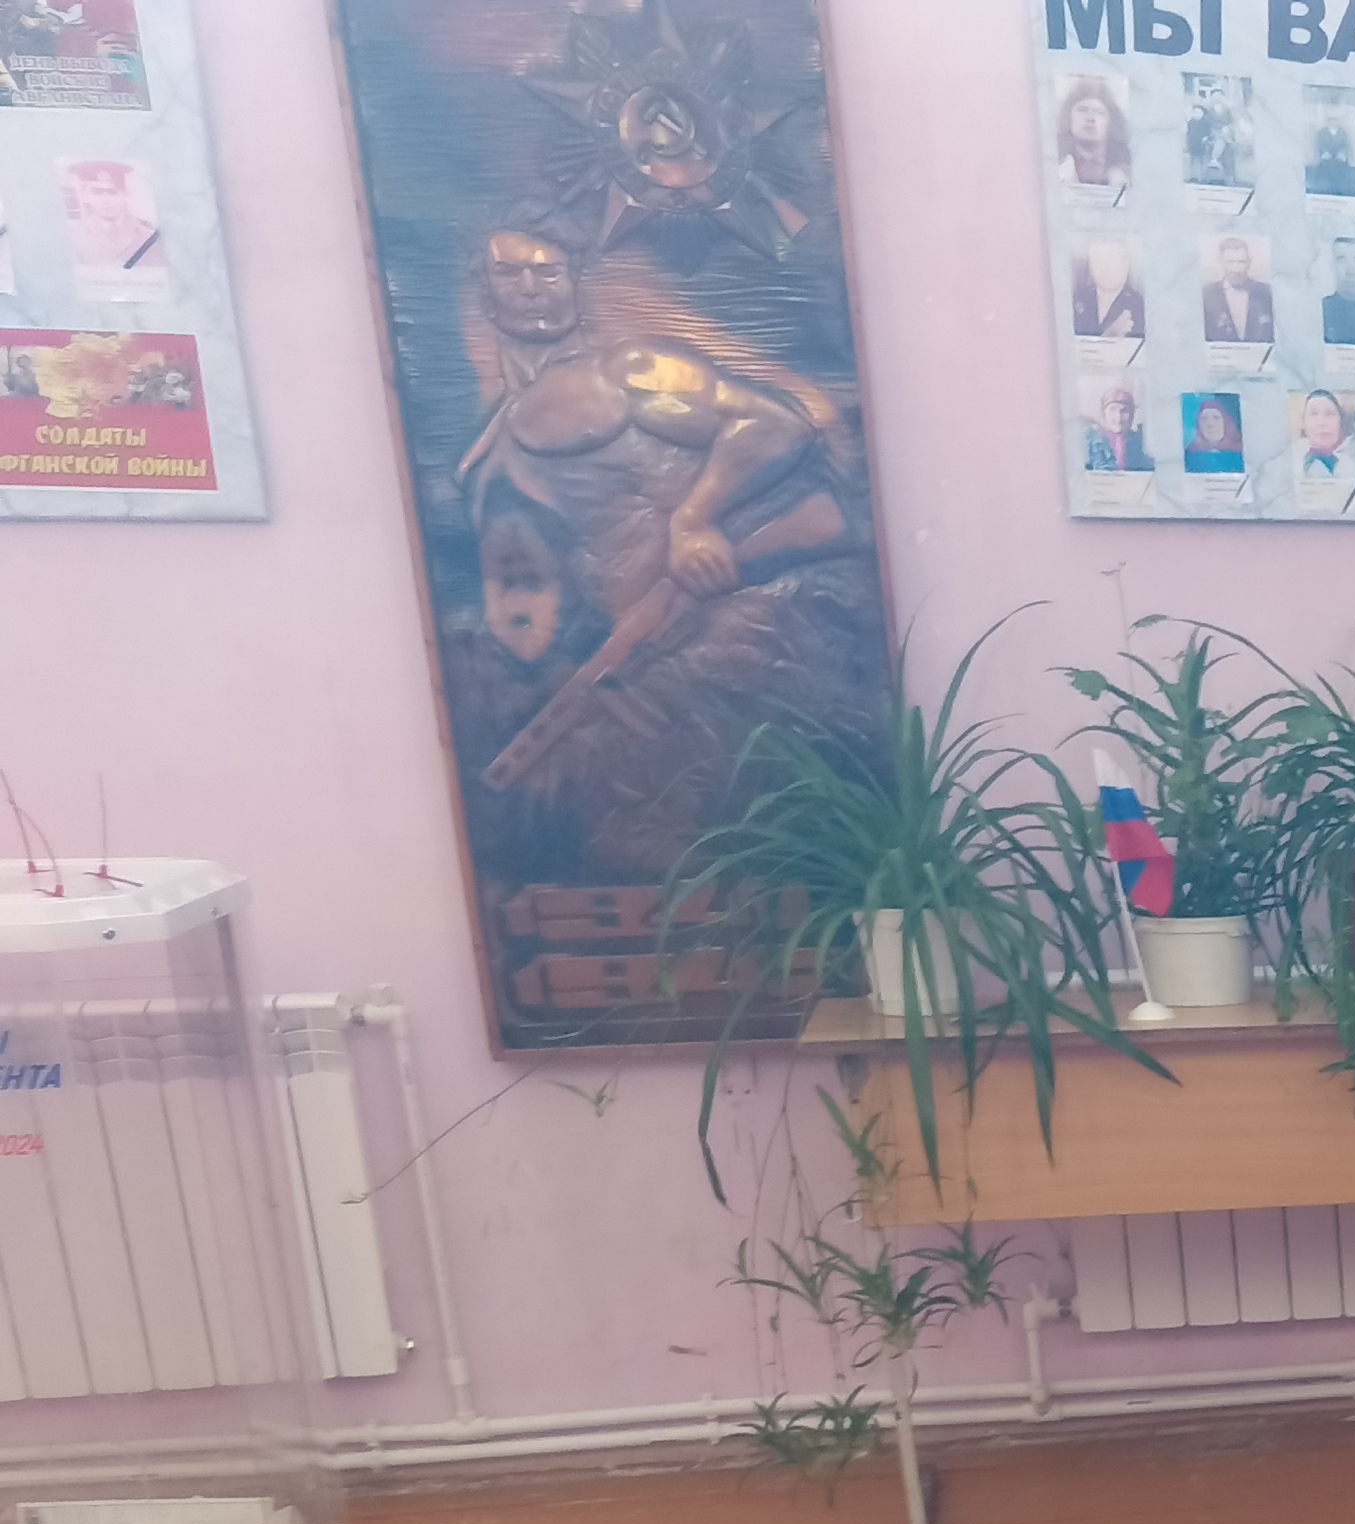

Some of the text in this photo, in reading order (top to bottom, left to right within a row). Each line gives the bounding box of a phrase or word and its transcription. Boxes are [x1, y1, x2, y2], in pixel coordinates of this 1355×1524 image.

[1045, 0, 1222, 55] МЫ
[35, 425, 147, 448] СОЛДАТЫ
[128, 454, 207, 477] ВОЙНЫ
[0, 1063, 61, 1090] НТА
